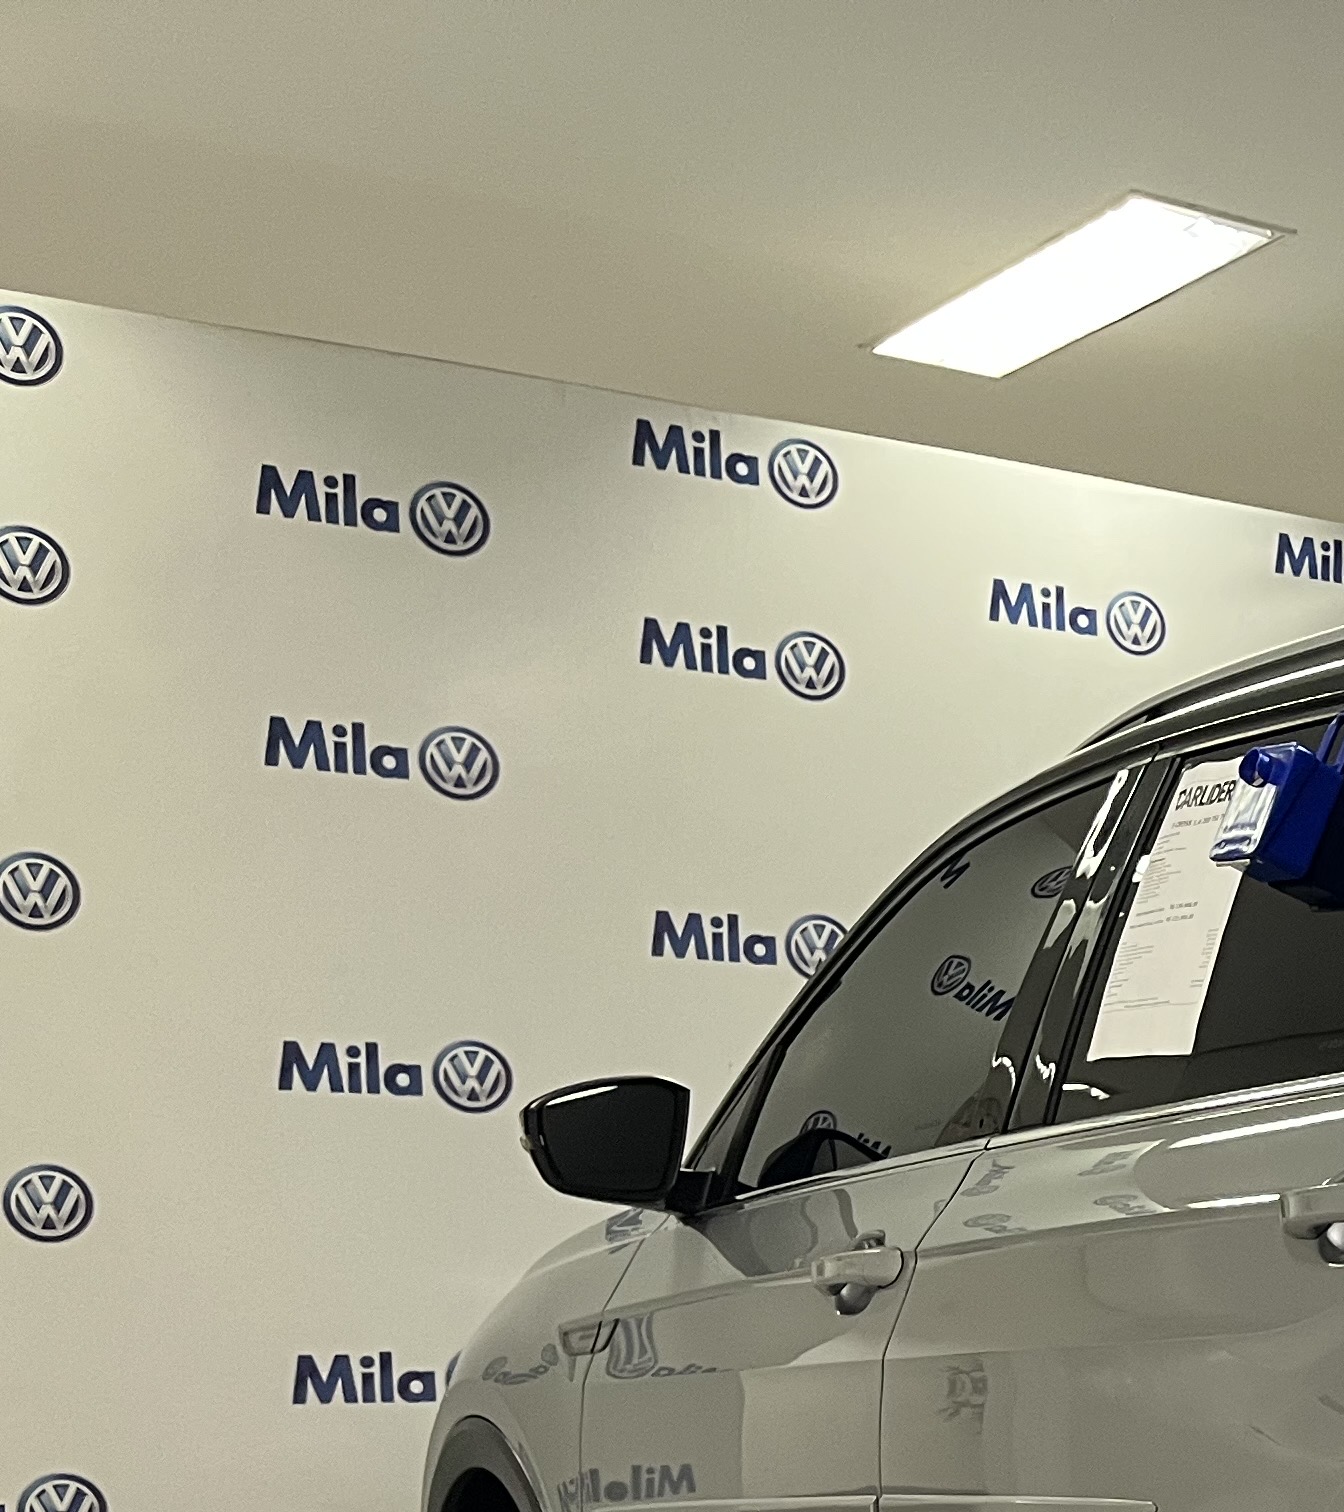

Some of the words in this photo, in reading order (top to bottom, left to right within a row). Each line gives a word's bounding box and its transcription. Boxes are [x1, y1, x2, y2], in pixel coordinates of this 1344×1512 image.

[632, 418, 759, 485] Mila
[256, 464, 400, 533] Mila
[989, 579, 1097, 636] Mila
[640, 617, 766, 680] Mila
[265, 716, 409, 779] Mila
[652, 910, 777, 965] Mila
[278, 1041, 422, 1096] Mila
[293, 1352, 436, 1404] Mila
